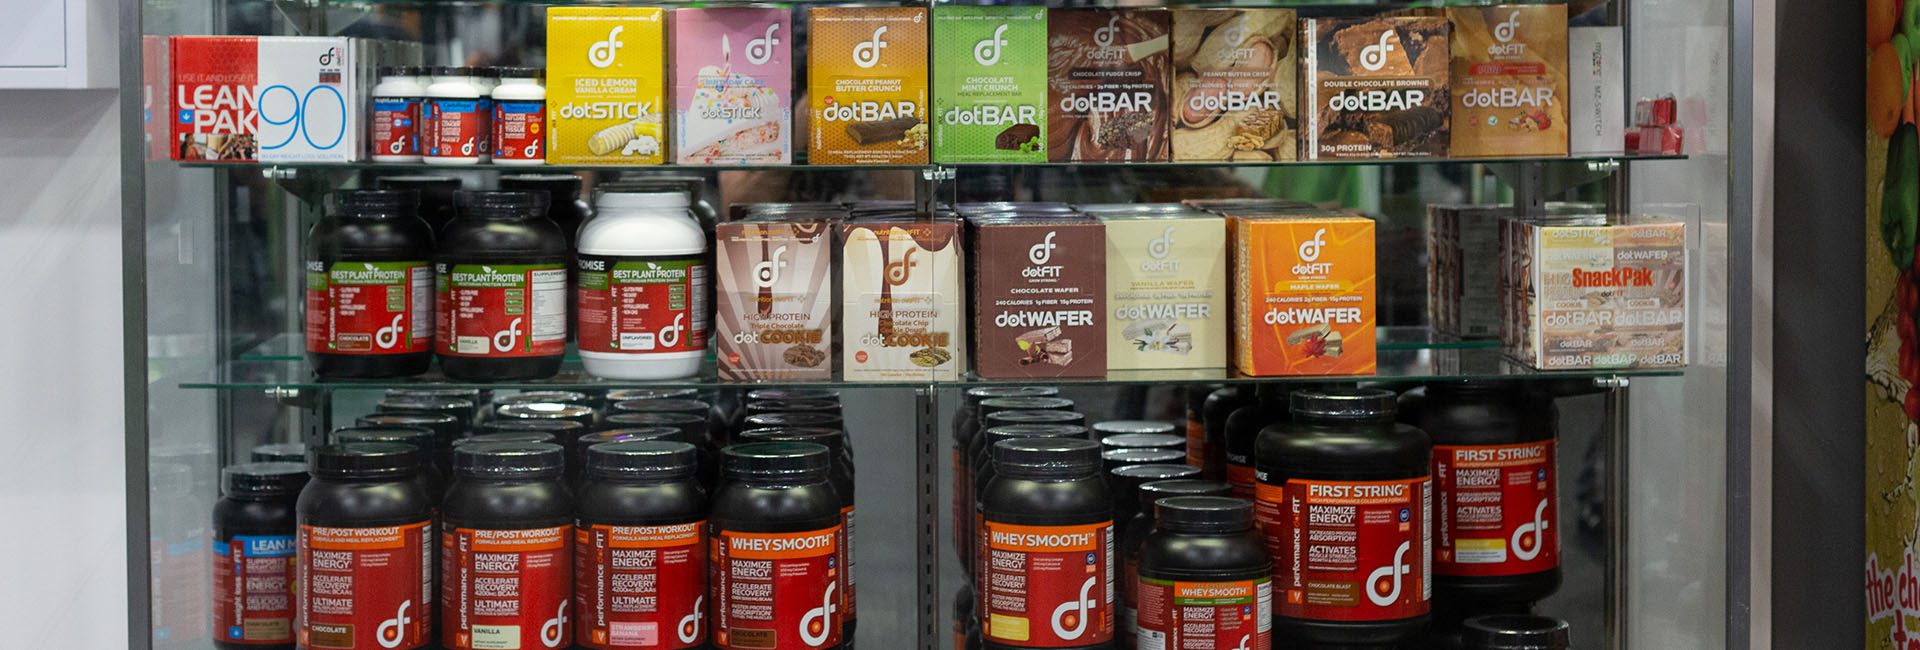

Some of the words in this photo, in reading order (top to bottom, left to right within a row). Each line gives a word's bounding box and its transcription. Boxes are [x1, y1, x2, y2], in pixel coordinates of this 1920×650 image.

[1087, 49, 1126, 59] dotFIT
[1217, 48, 1255, 59] dotFIT
[1488, 43, 1526, 55] dotFIT
[575, 79, 598, 87] ICED
[601, 79, 637, 87] LEMON
[178, 85, 258, 110] LEAN
[1060, 92, 1152, 112] dotBAR
[1190, 91, 1280, 111] dotBAR
[1328, 90, 1424, 111] dotBAR
[1462, 87, 1553, 108] dotBAR
[560, 102, 652, 119] dotSTICK
[702, 107, 761, 119] dotSTICK
[823, 101, 915, 122] dotBAR
[944, 106, 1036, 125] dotBAR
[194, 110, 258, 134] PAK
[258, 85, 346, 150] 90
[1617, 250, 1668, 260] dotWAFER
[613, 270, 631, 278] BEST
[632, 270, 656, 278] PLANT
[657, 270, 686, 278] PROTEIN
[1022, 266, 1062, 277] dotFIT
[1292, 263, 1331, 274] dotFIT
[331, 271, 348, 279] BEST
[349, 271, 373, 280] PLANT
[374, 271, 405, 279] PROTEIN
[452, 273, 467, 282] BEST
[468, 273, 491, 282] PLANT
[492, 273, 524, 282] PROTEIN
[1115, 303, 1210, 320] dotWAFER
[1264, 307, 1361, 324] dotWAFER
[995, 310, 1093, 327] dotWAFER
[1545, 310, 1612, 326] dotBAR
[1615, 310, 1681, 324] dotBAR
[760, 329, 823, 344] COOKIE
[886, 332, 950, 347] COOKIE
[1560, 340, 1593, 348] dotBAR
[1548, 355, 1591, 365] dotBAR
[1640, 354, 1681, 364] dotBAR
[1456, 450, 1496, 461] FIRST
[1456, 469, 1500, 477] MAXIMIZE
[1456, 477, 1497, 486] ENERGY
[1310, 485, 1352, 497] FIRST
[1292, 496, 1300, 513] FIT
[1309, 506, 1356, 514] MAXIMIZE
[1456, 506, 1502, 514] ACTIVATES
[1310, 514, 1353, 523] ENERGY
[313, 527, 354, 536] PRE/POST
[354, 526, 400, 536] WORKOUT
[475, 530, 520, 539] PRE/POST
[521, 527, 560, 537] WORKOUT
[612, 526, 657, 535] PRE/POST
[658, 523, 695, 533] WORKOUT
[252, 540, 285, 551] LEAN
[1309, 545, 1356, 554] ACTIVATES
[313, 551, 352, 560] MAXIMIZE
[475, 554, 519, 562] MAXIMIZE
[612, 550, 656, 558] MAXIMIZE
[992, 550, 1025, 560] MAXIMIZE
[1292, 528, 1301, 587] performance
[313, 560, 351, 569] ENERGY
[475, 562, 516, 570] ENERGY
[612, 558, 654, 567] ENERGY
[732, 560, 772, 569] MAXIMIZE
[992, 559, 1024, 569] ENERGY
[732, 569, 770, 577] ENERGY
[992, 573, 1025, 582] ACCELERATE
[313, 575, 352, 583] ACCELERATE
[992, 580, 1024, 588] RECOVERY
[1866, 559, 1894, 617] the
[1899, 553, 1920, 611] ch
[597, 564, 605, 626] performance
[612, 596, 656, 604] ULTIMATE
[313, 597, 352, 607] ULTIMATE
[475, 600, 519, 609] ULTIMATE
